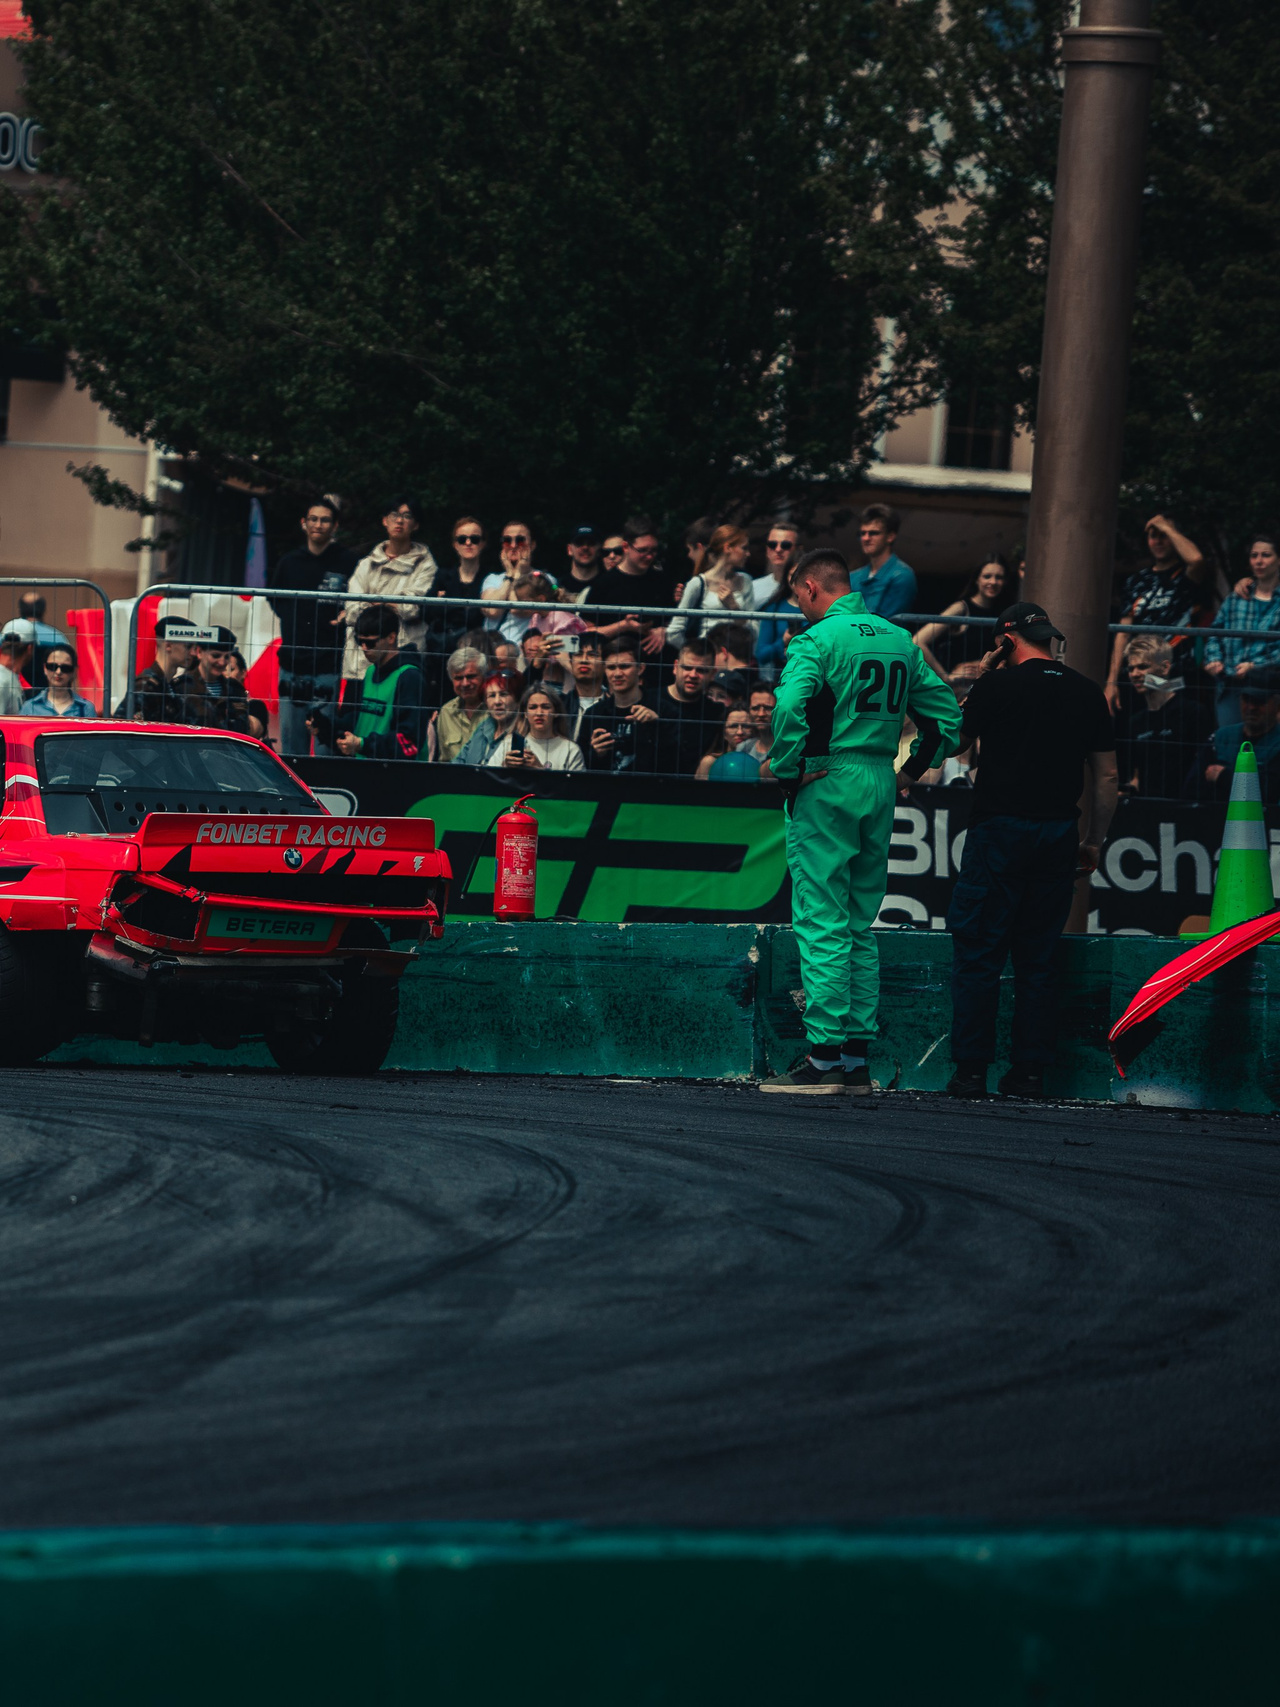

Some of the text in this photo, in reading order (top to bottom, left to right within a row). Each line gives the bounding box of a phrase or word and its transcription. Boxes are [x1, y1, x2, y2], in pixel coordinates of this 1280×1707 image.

[196, 630, 212, 638] LINE
[854, 659, 908, 714] 20
[196, 822, 387, 847] FONBET RACING
